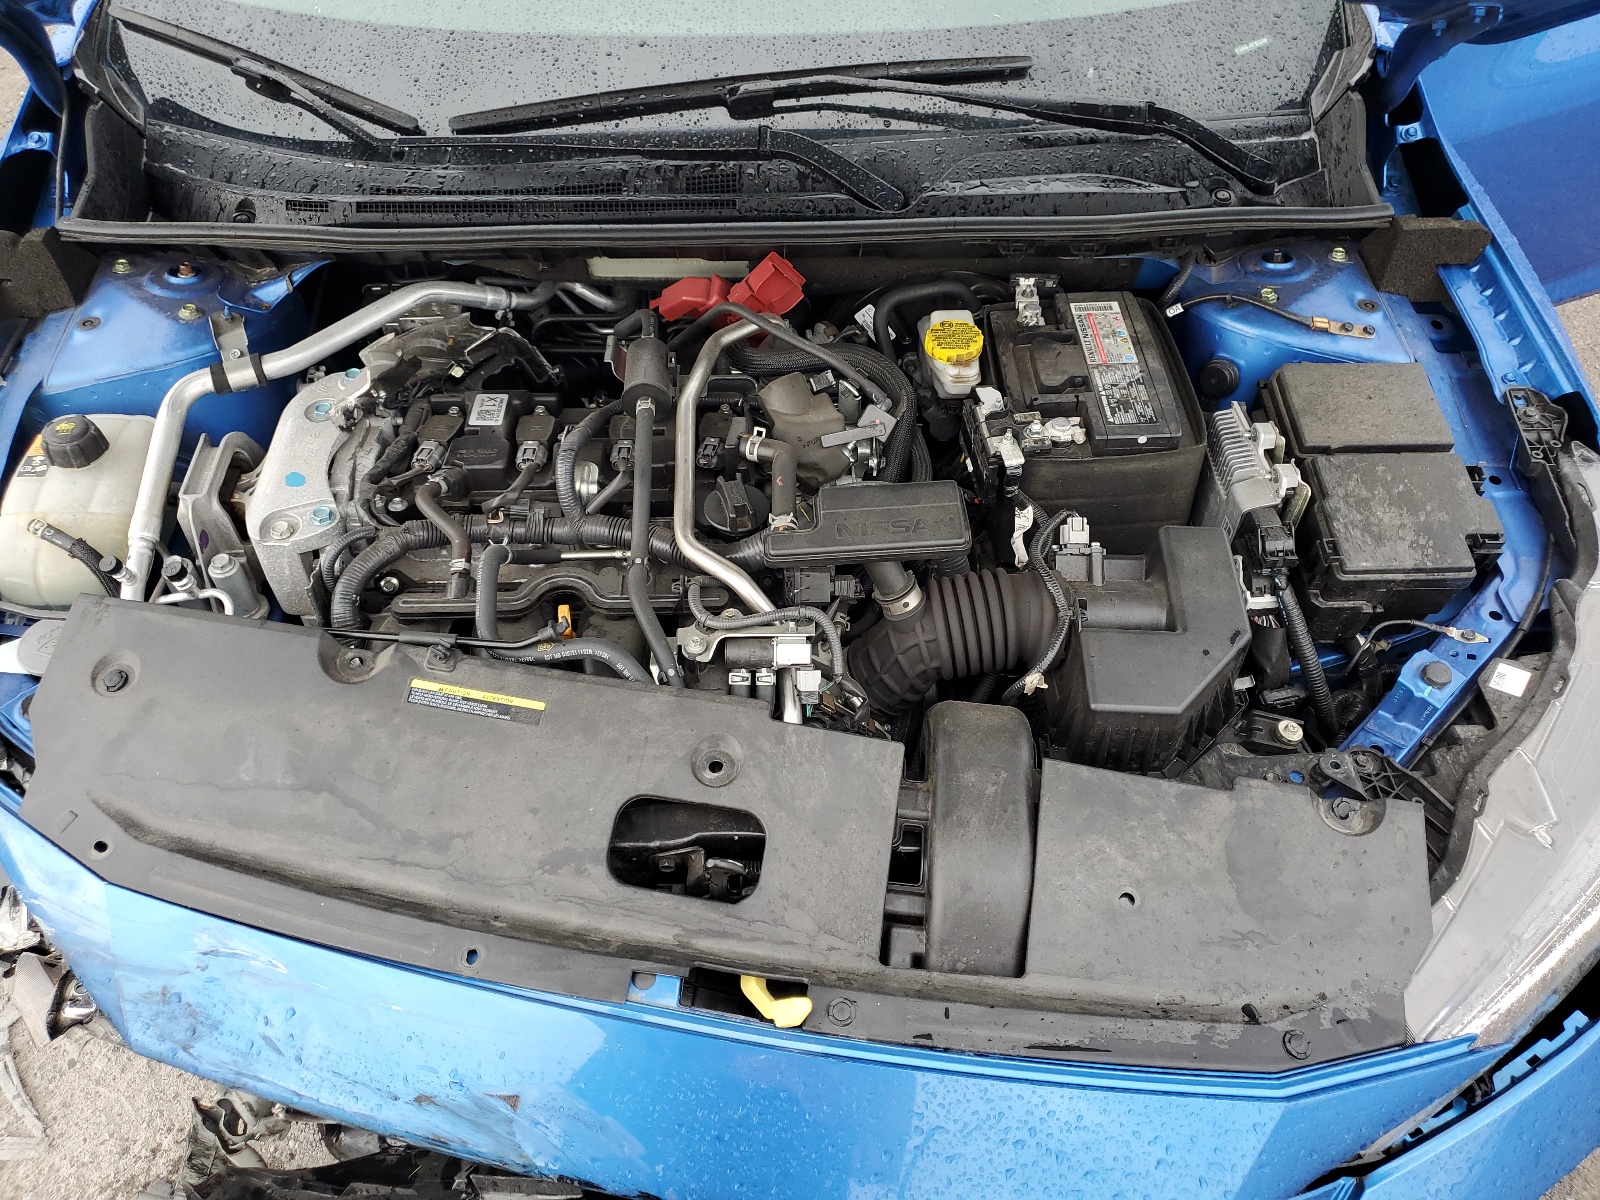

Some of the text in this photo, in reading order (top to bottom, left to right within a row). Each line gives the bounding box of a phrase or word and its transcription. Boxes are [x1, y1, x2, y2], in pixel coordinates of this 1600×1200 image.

[1075, 314, 1089, 339] NISSAN
[444, 687, 471, 697] CAUTION
[482, 694, 514, 704] ATTENTION
